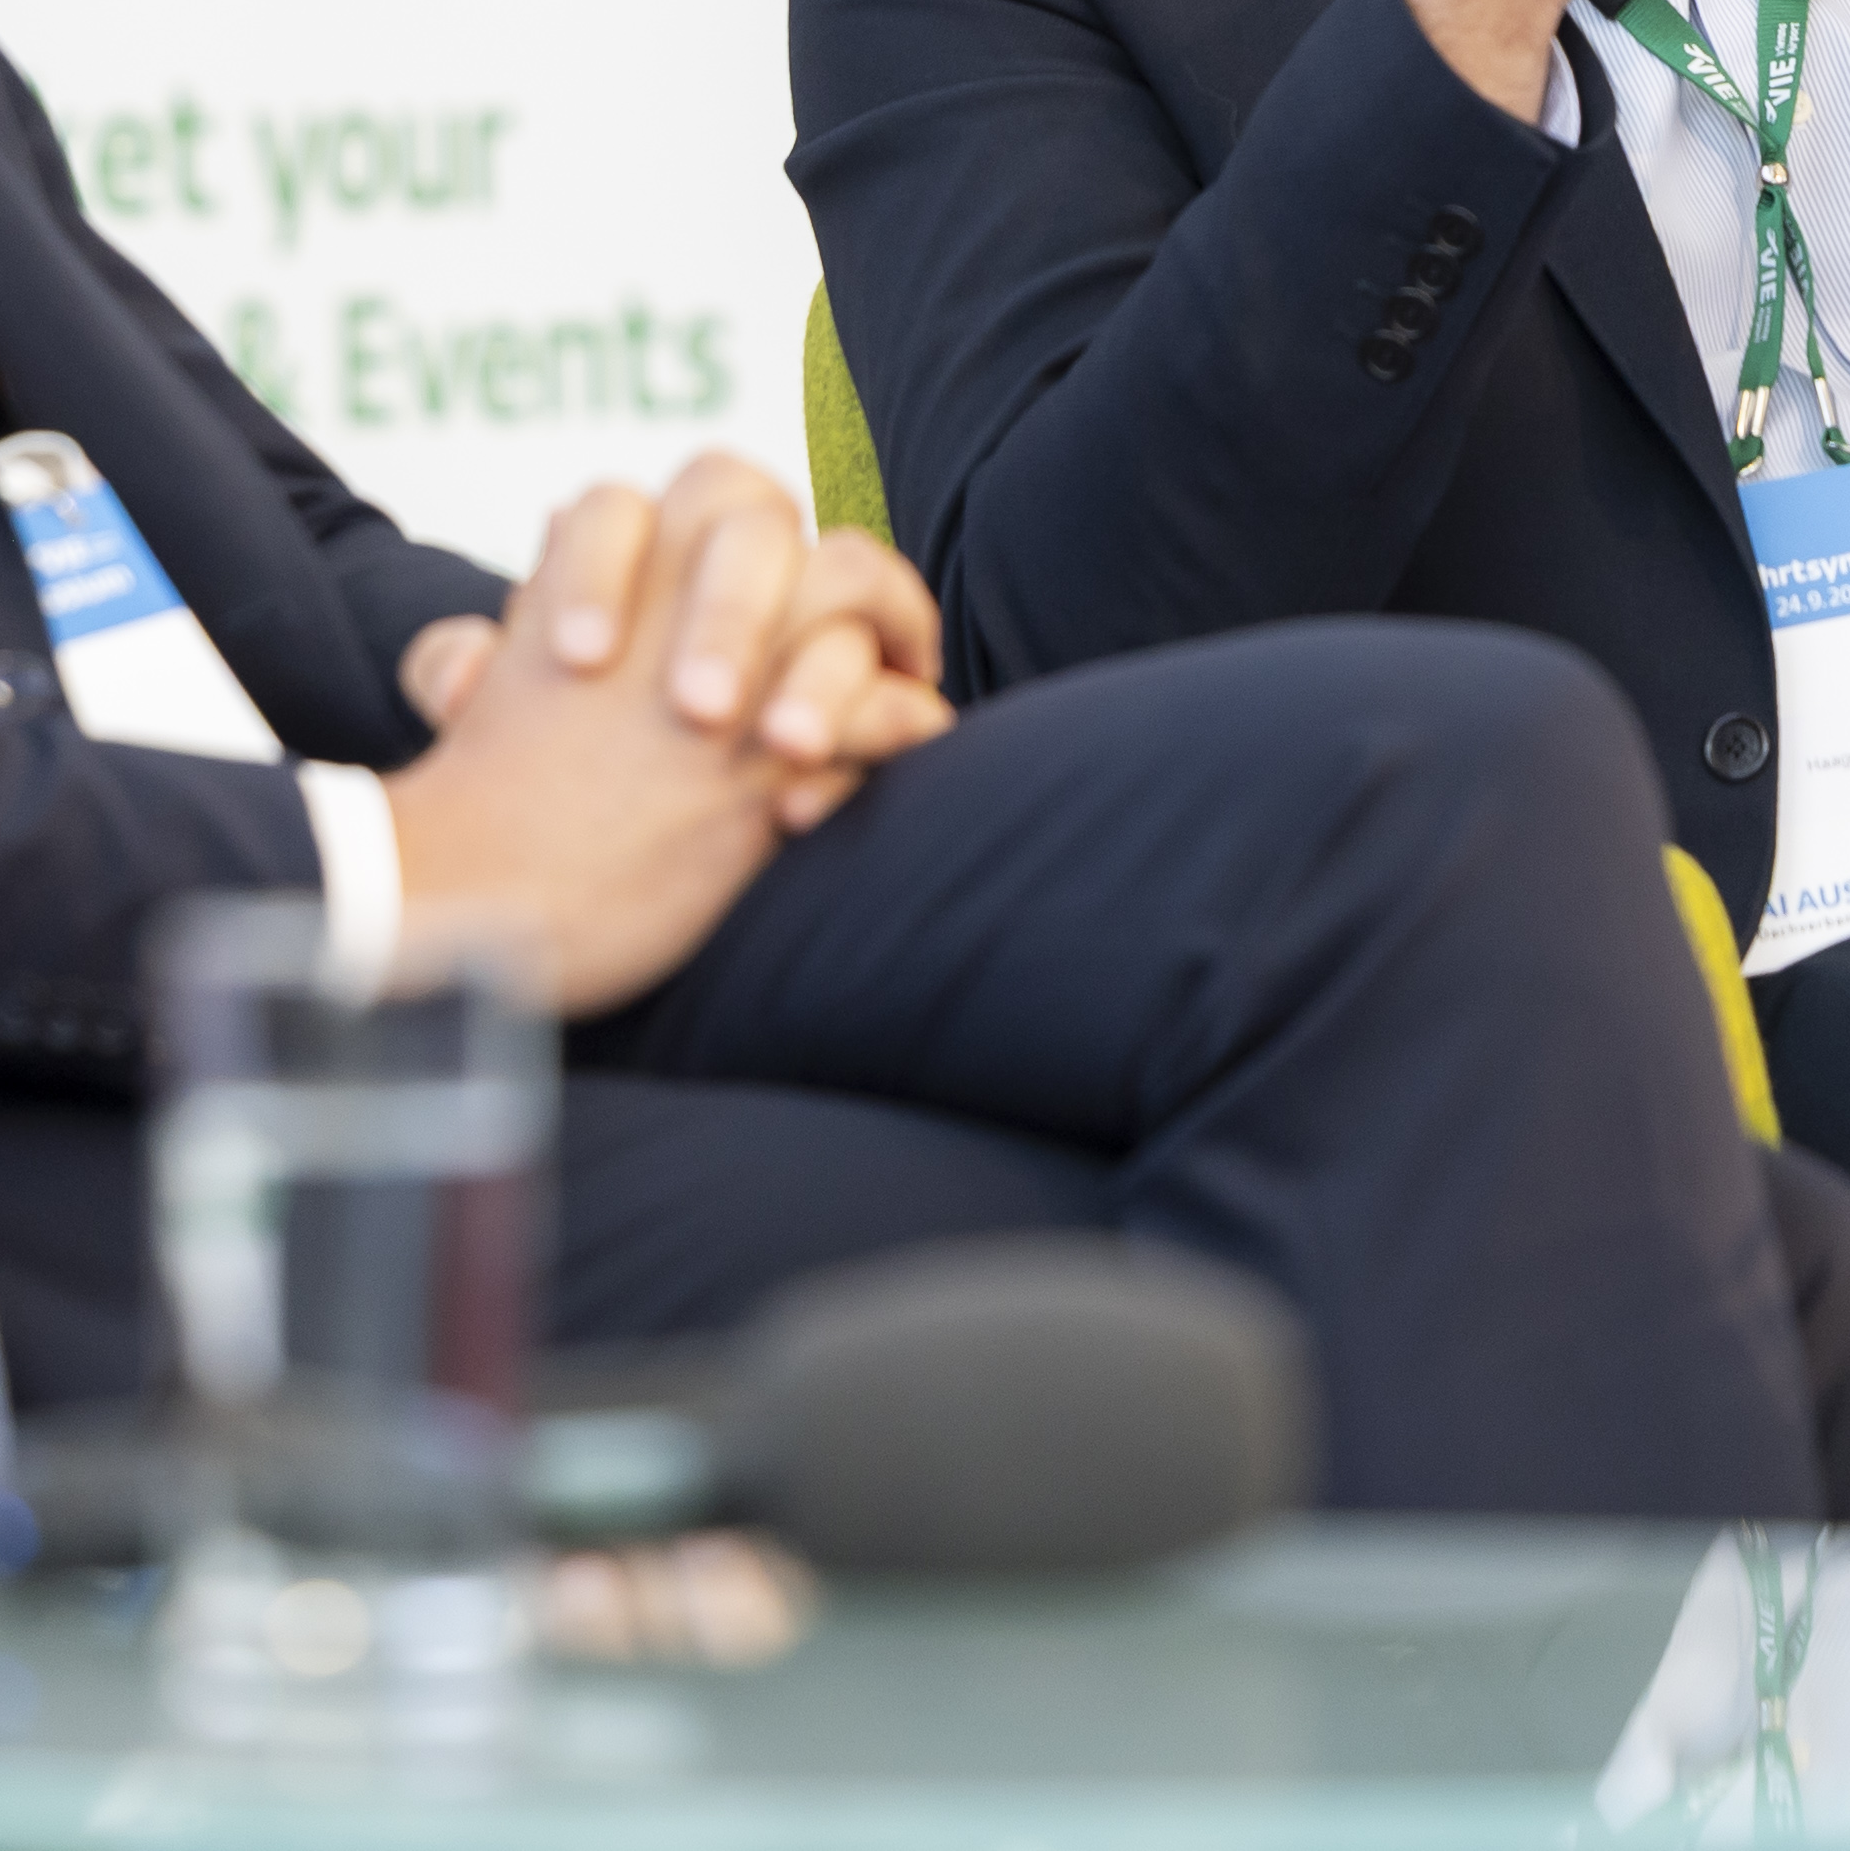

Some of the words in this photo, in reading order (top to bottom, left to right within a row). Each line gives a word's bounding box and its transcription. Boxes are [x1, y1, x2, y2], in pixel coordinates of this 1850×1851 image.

[1687, 57, 1739, 100] VIE
[1768, 57, 1797, 107] VIE
[251, 98, 517, 254] your
[1761, 247, 1777, 304] VIE
[339, 297, 739, 427] Events
